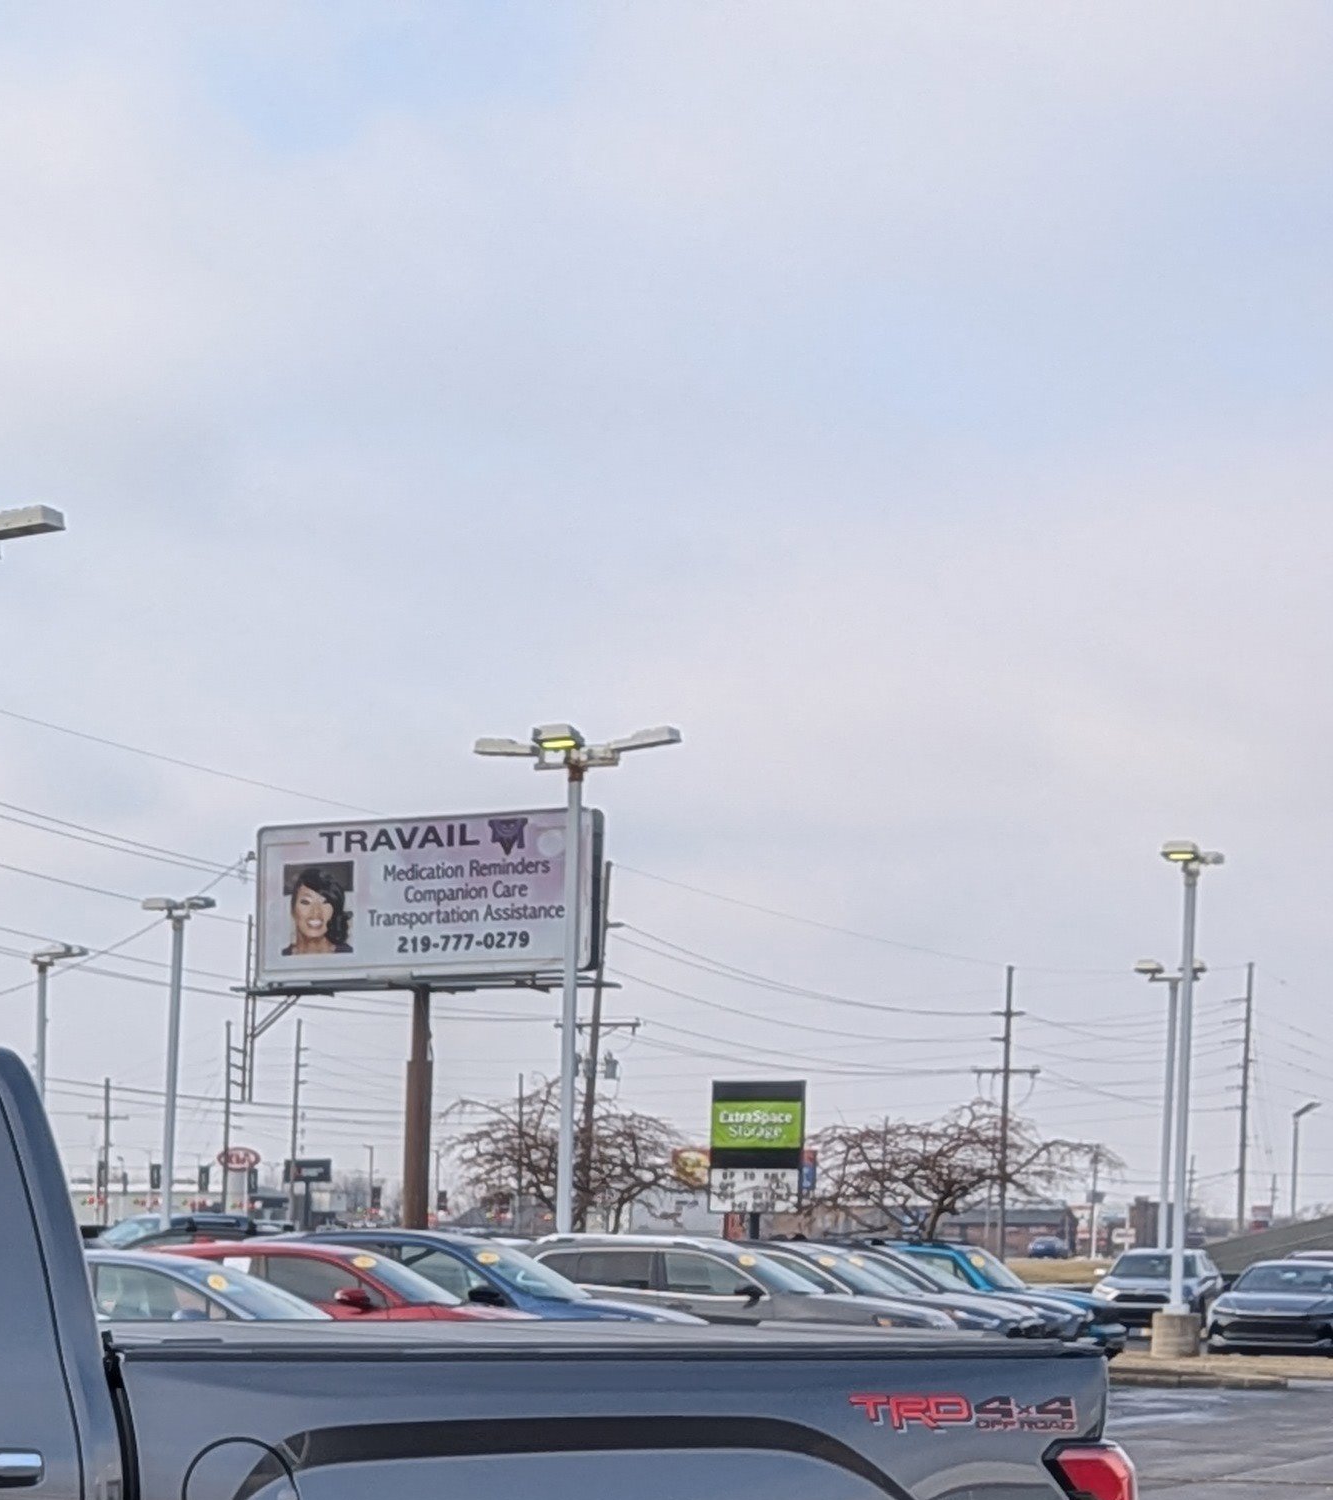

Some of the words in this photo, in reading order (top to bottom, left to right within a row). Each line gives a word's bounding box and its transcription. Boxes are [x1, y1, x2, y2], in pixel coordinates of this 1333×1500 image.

[319, 823, 481, 854] TRAVAIL
[383, 860, 464, 882] Medication
[469, 857, 551, 877] Reminders
[404, 882, 488, 906] Companion
[492, 881, 528, 899] Care
[368, 905, 479, 928] Transportation
[483, 903, 565, 922] Assistance
[397, 931, 530, 953] 219-777-0279
[849, 1392, 974, 1432] TRD
[974, 1395, 1076, 1421] 4x4
[975, 1420, 1016, 1432] OFF
[1020, 1420, 1076, 1432] ROAD
